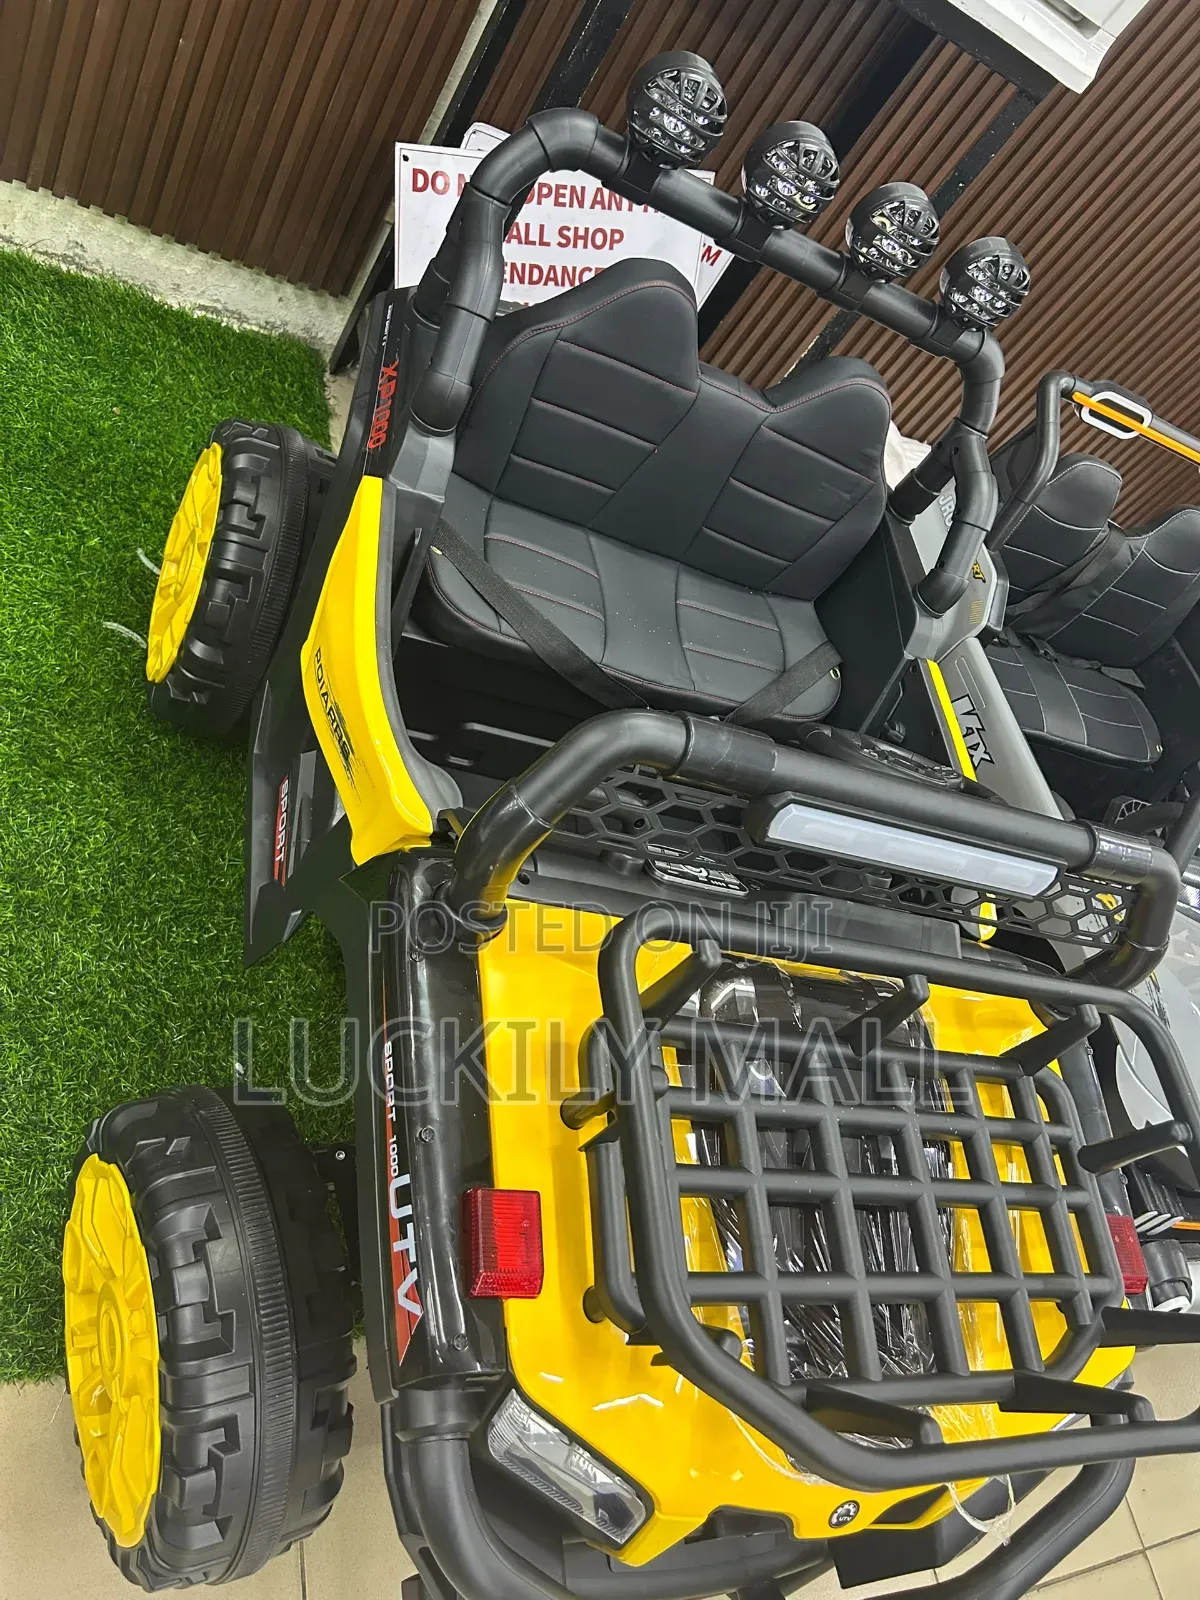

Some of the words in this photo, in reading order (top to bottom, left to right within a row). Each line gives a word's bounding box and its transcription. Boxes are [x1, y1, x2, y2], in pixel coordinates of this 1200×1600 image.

[411, 167, 450, 196] DO
[505, 221, 551, 247] ALL
[557, 225, 625, 251] SHOP
[368, 358, 399, 449] XP1000
[275, 778, 290, 863] SPORT
[384, 1040, 397, 1122] SPORT
[389, 1134, 400, 1178] 1000
[388, 1173, 424, 1317] UTV
